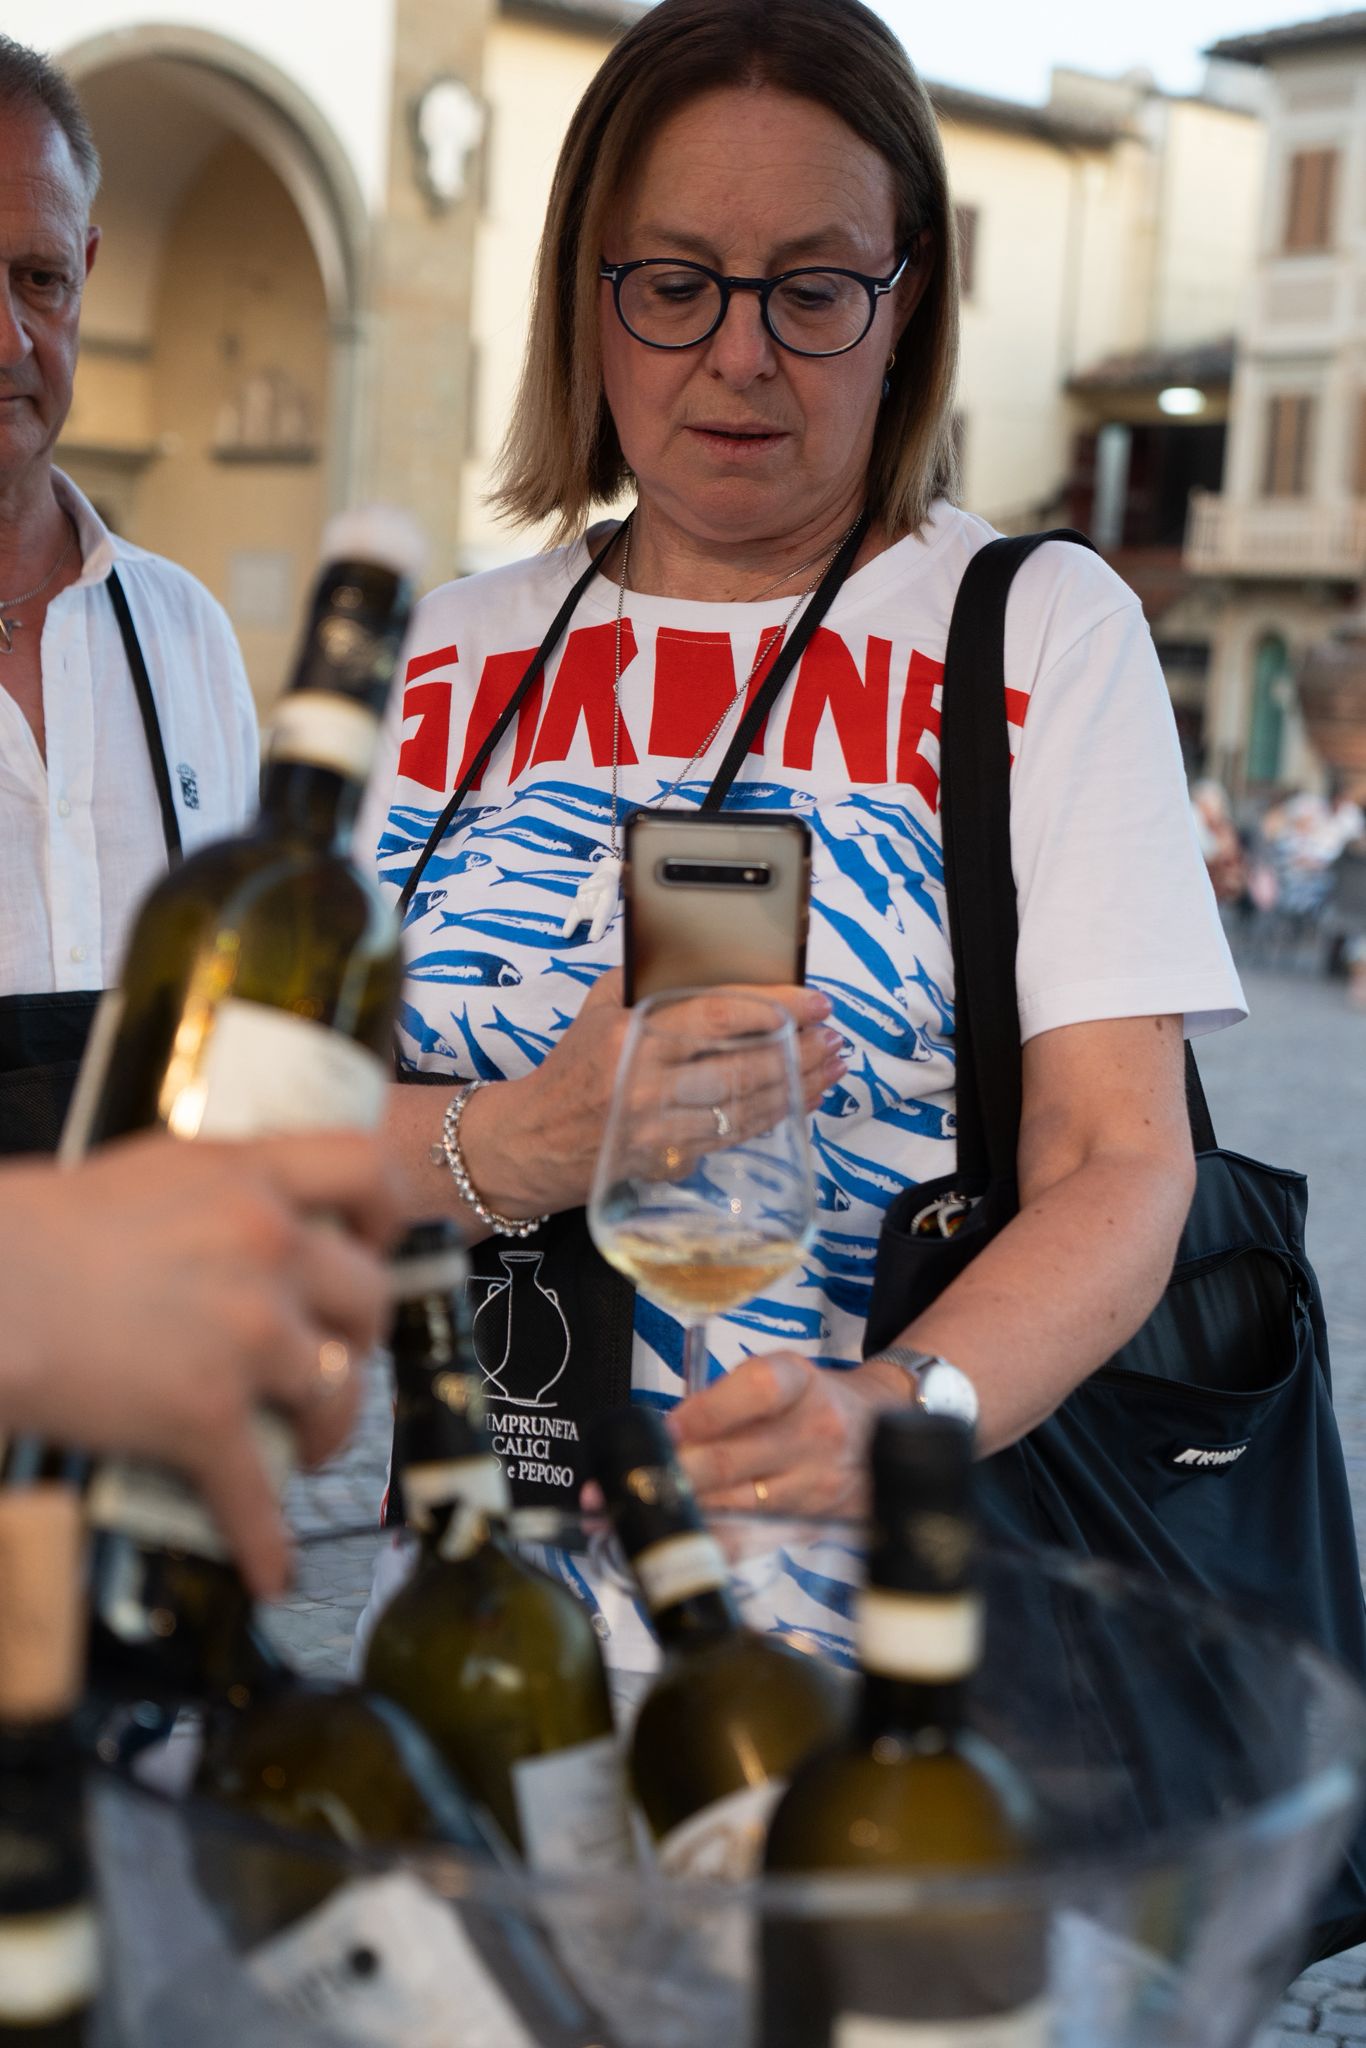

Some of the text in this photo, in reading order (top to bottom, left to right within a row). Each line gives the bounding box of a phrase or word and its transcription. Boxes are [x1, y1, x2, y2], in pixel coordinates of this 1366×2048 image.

[486, 1413, 579, 1441] IMPRUNETA
[492, 1436, 550, 1459] CALICI
[507, 1465, 515, 1478] e
[518, 1461, 574, 1487] PEPOSO
